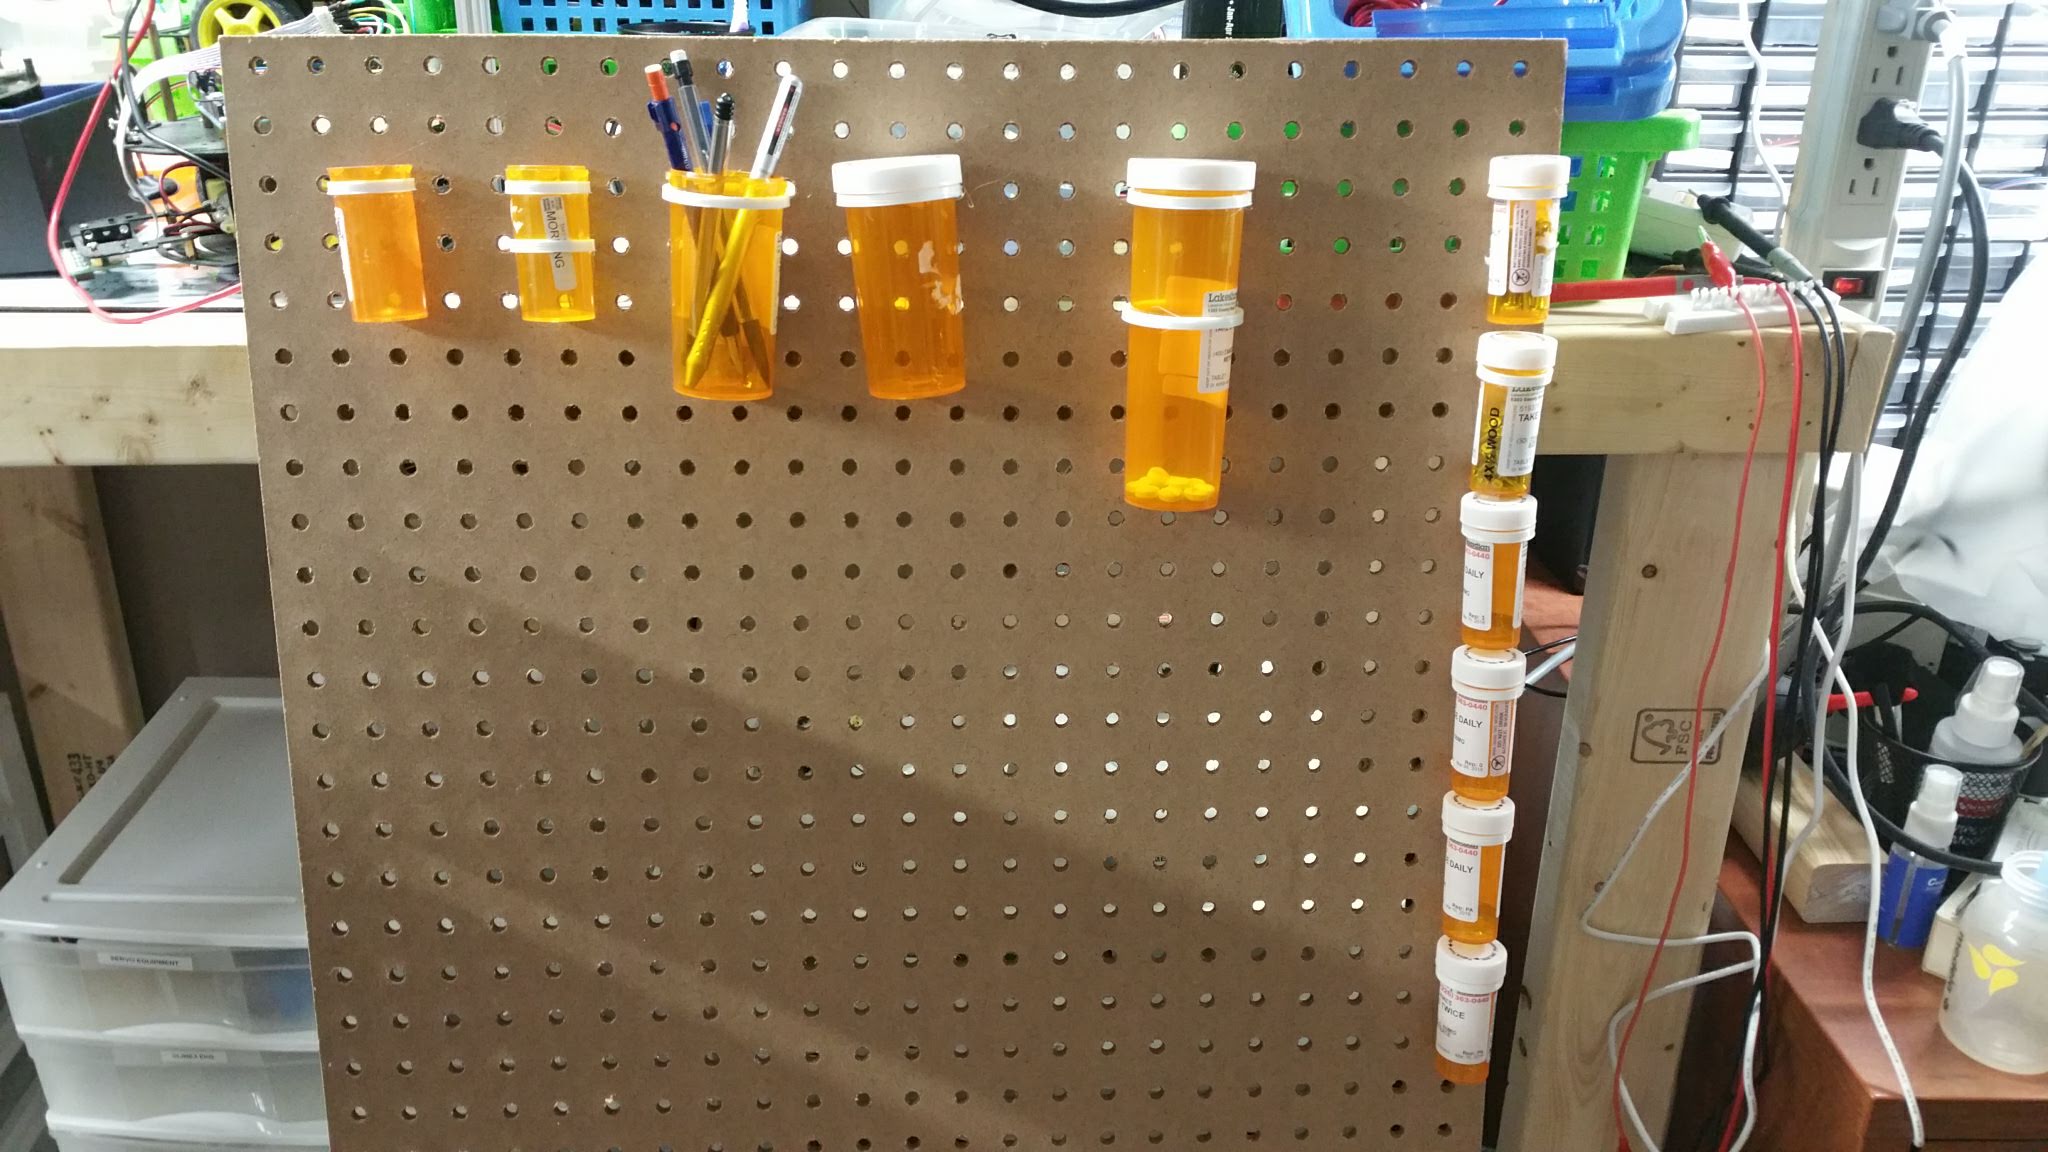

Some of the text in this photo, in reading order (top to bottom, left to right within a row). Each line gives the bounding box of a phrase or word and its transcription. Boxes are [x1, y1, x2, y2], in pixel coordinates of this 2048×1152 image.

[546, 211, 566, 269] MORNG
[1486, 407, 1500, 450] WOOD
[1458, 715, 1483, 729] DAILY
[1675, 720, 1693, 756] FSC
[1449, 859, 1474, 874] DAILY
[1441, 1002, 1466, 1019] TWICE
